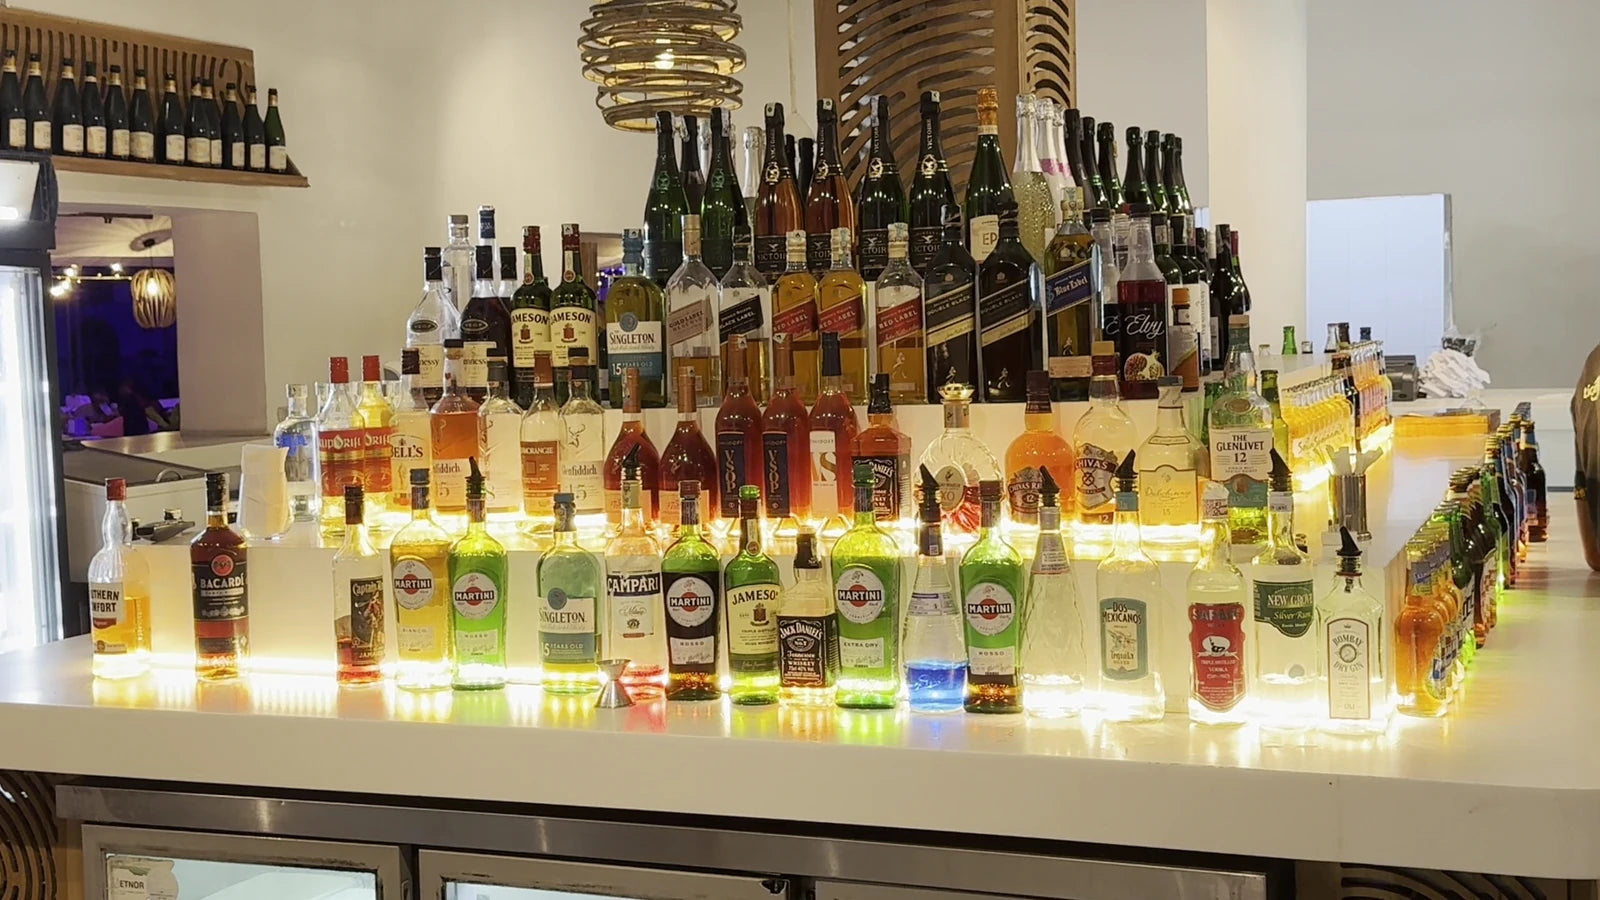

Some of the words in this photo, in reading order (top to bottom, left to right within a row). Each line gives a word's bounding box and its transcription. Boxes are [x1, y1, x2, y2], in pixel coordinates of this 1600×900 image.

[983, 232, 998, 245] EP
[879, 319, 893, 329] RED
[895, 310, 918, 322] LABEL
[609, 332, 655, 345] SINGLETON
[612, 363, 622, 376] 15
[1232, 434, 1248, 442] THE
[1216, 441, 1264, 452] GLENLIVET
[1234, 452, 1248, 463] 12
[394, 579, 431, 589] MARTINI
[608, 575, 658, 593] CAMPARI
[456, 591, 494, 600] MARTINI
[732, 590, 778, 605] JAMESO
[839, 590, 881, 600] MARTINI
[1267, 594, 1287, 606] NEW
[670, 597, 710, 606] MARTINI
[1113, 602, 1128, 612] DOS
[969, 604, 1011, 614] MARTINI
[1103, 612, 1141, 625] MEXICANOS
